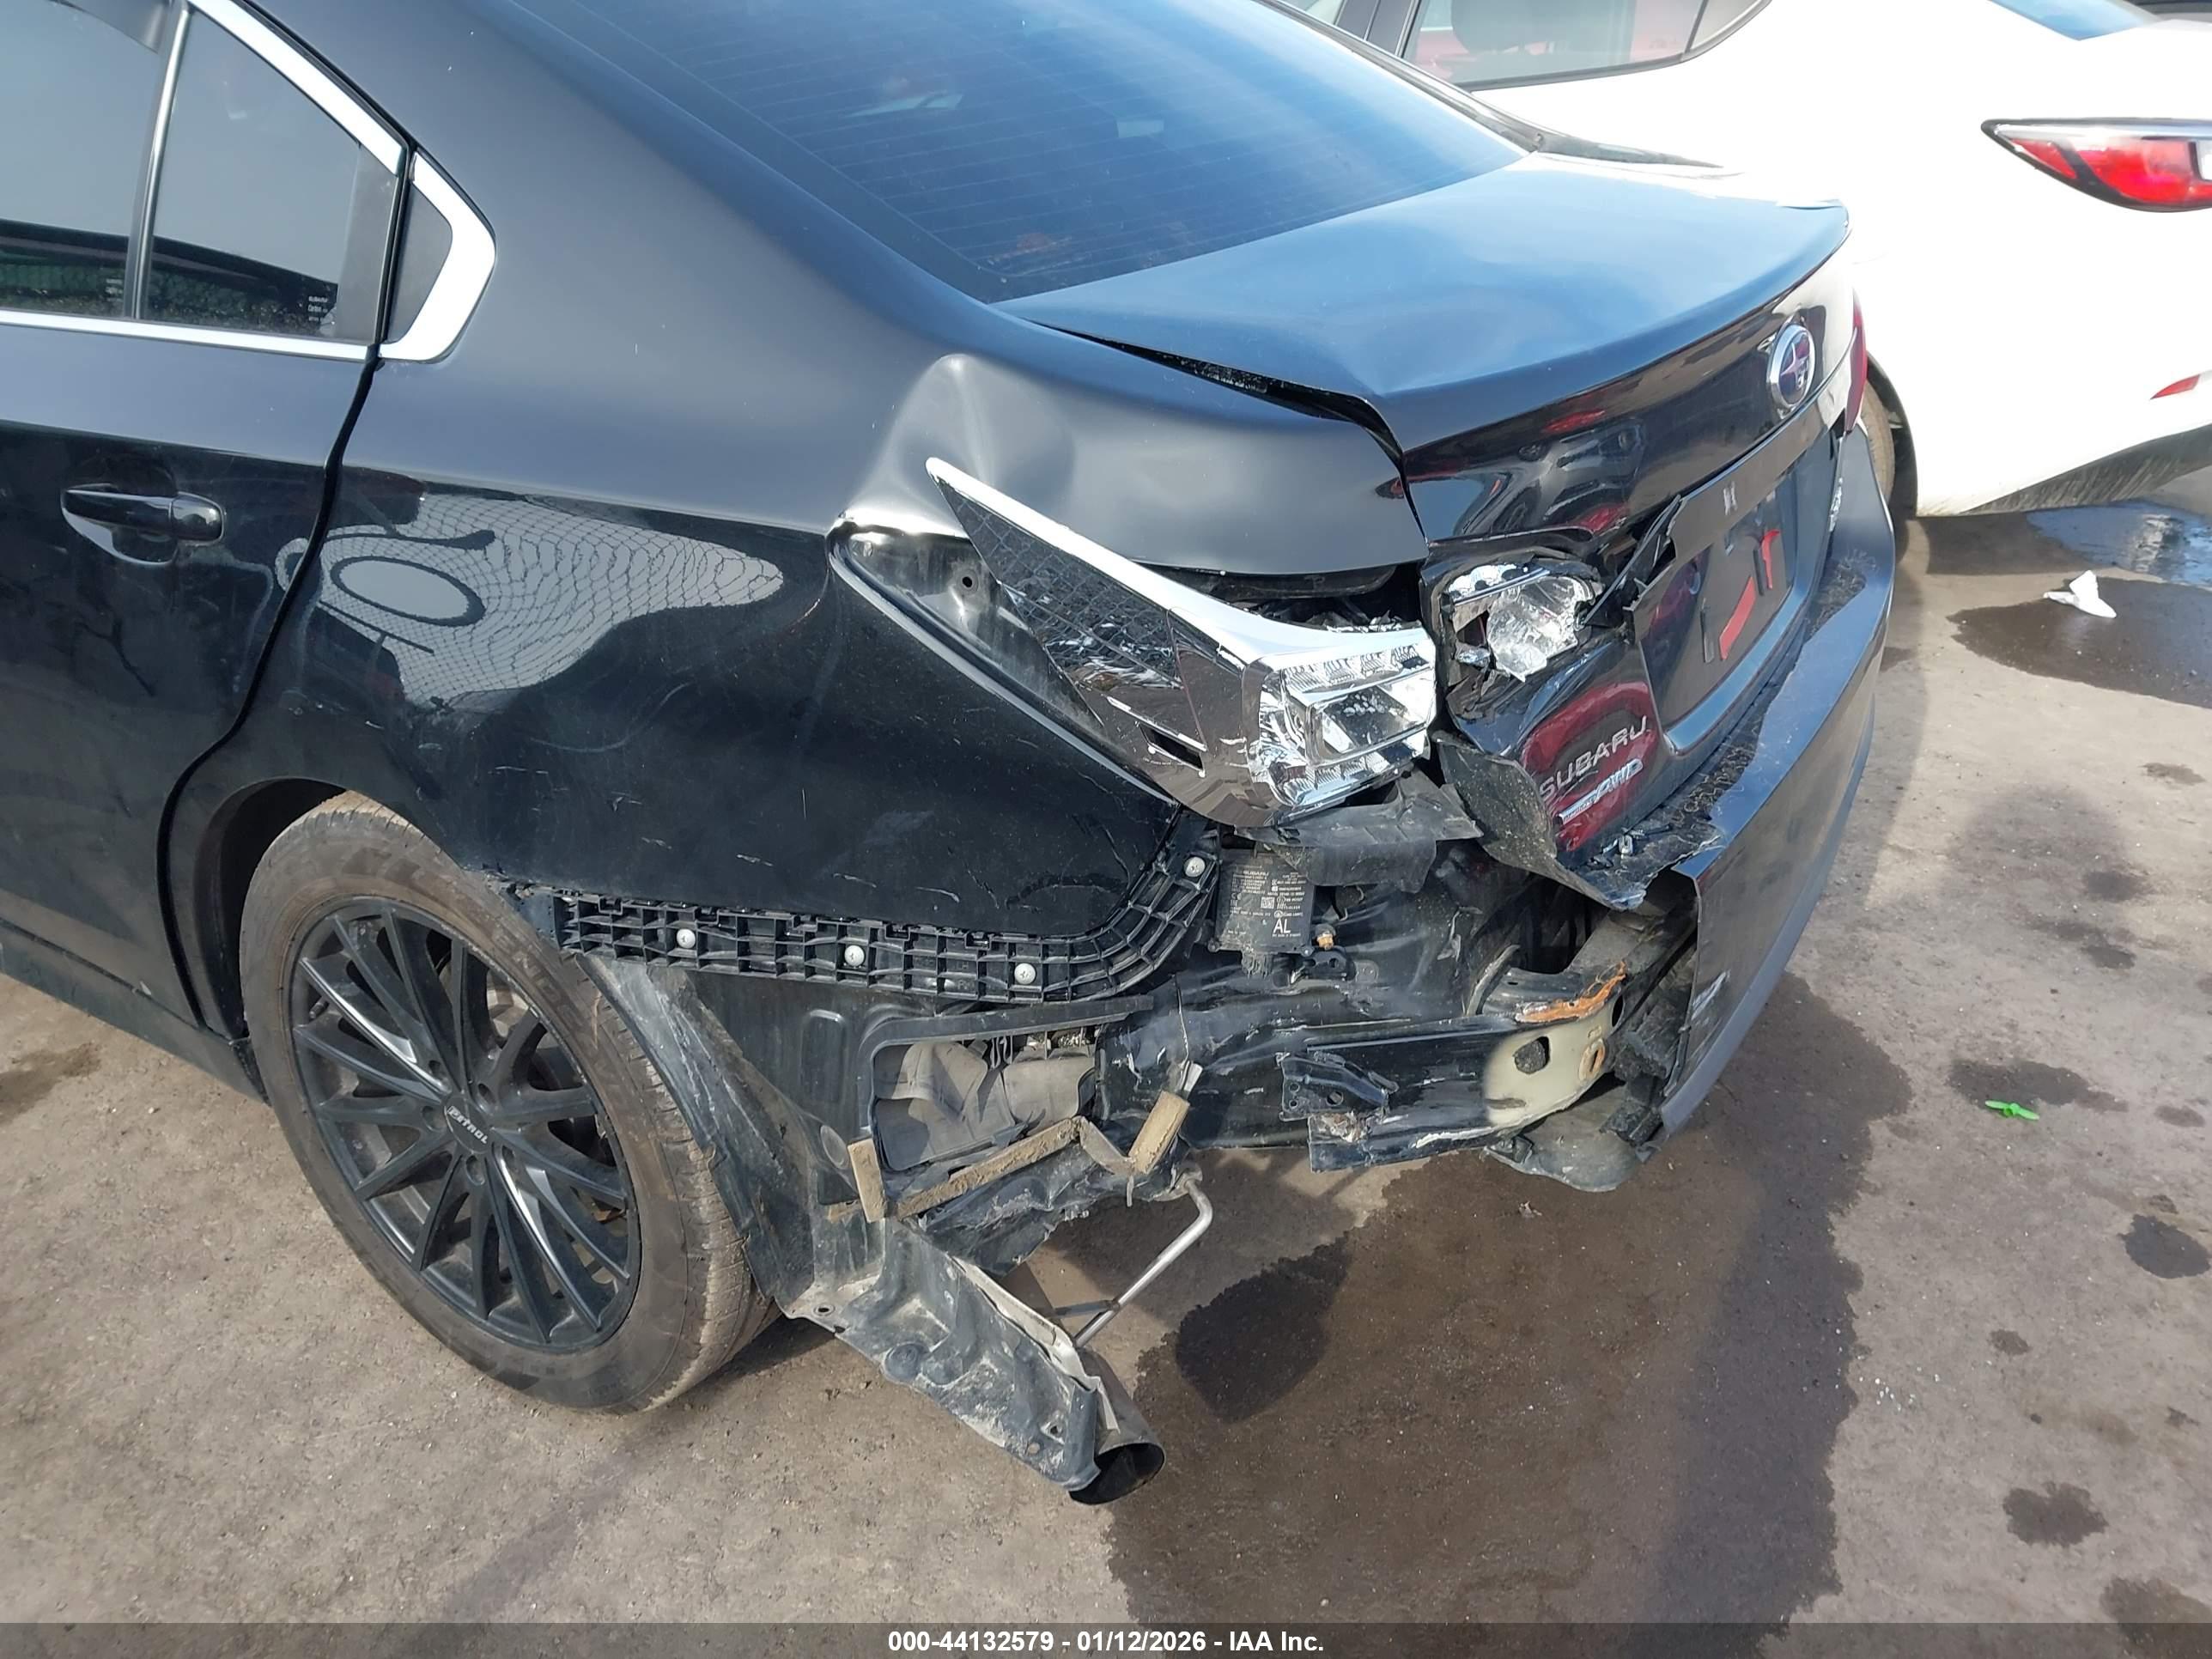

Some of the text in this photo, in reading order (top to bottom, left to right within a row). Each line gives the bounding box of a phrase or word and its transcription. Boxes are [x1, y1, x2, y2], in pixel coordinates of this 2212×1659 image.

[1539, 715, 1647, 804] SUBARU
[1594, 758, 1644, 805] AWD
[1273, 918, 1291, 934] AL
